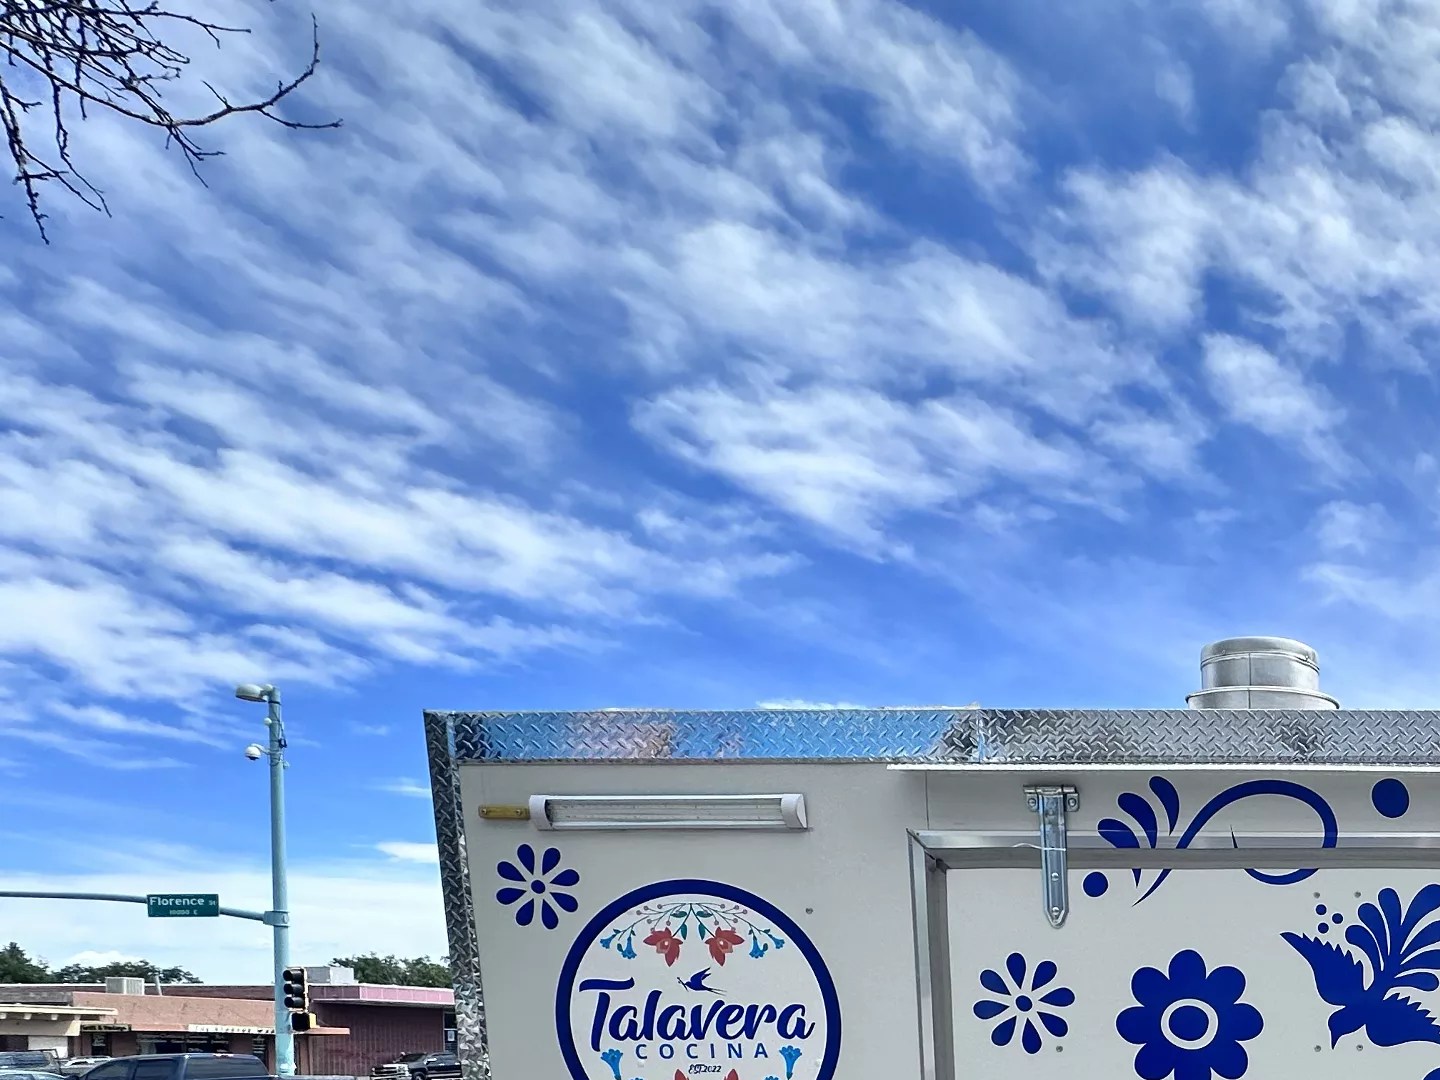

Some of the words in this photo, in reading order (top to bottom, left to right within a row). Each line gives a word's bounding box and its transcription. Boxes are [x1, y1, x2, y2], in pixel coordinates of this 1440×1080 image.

[149, 896, 205, 906] Florence
[579, 977, 815, 1052] Talavera
[635, 1043, 769, 1060] COCINA
